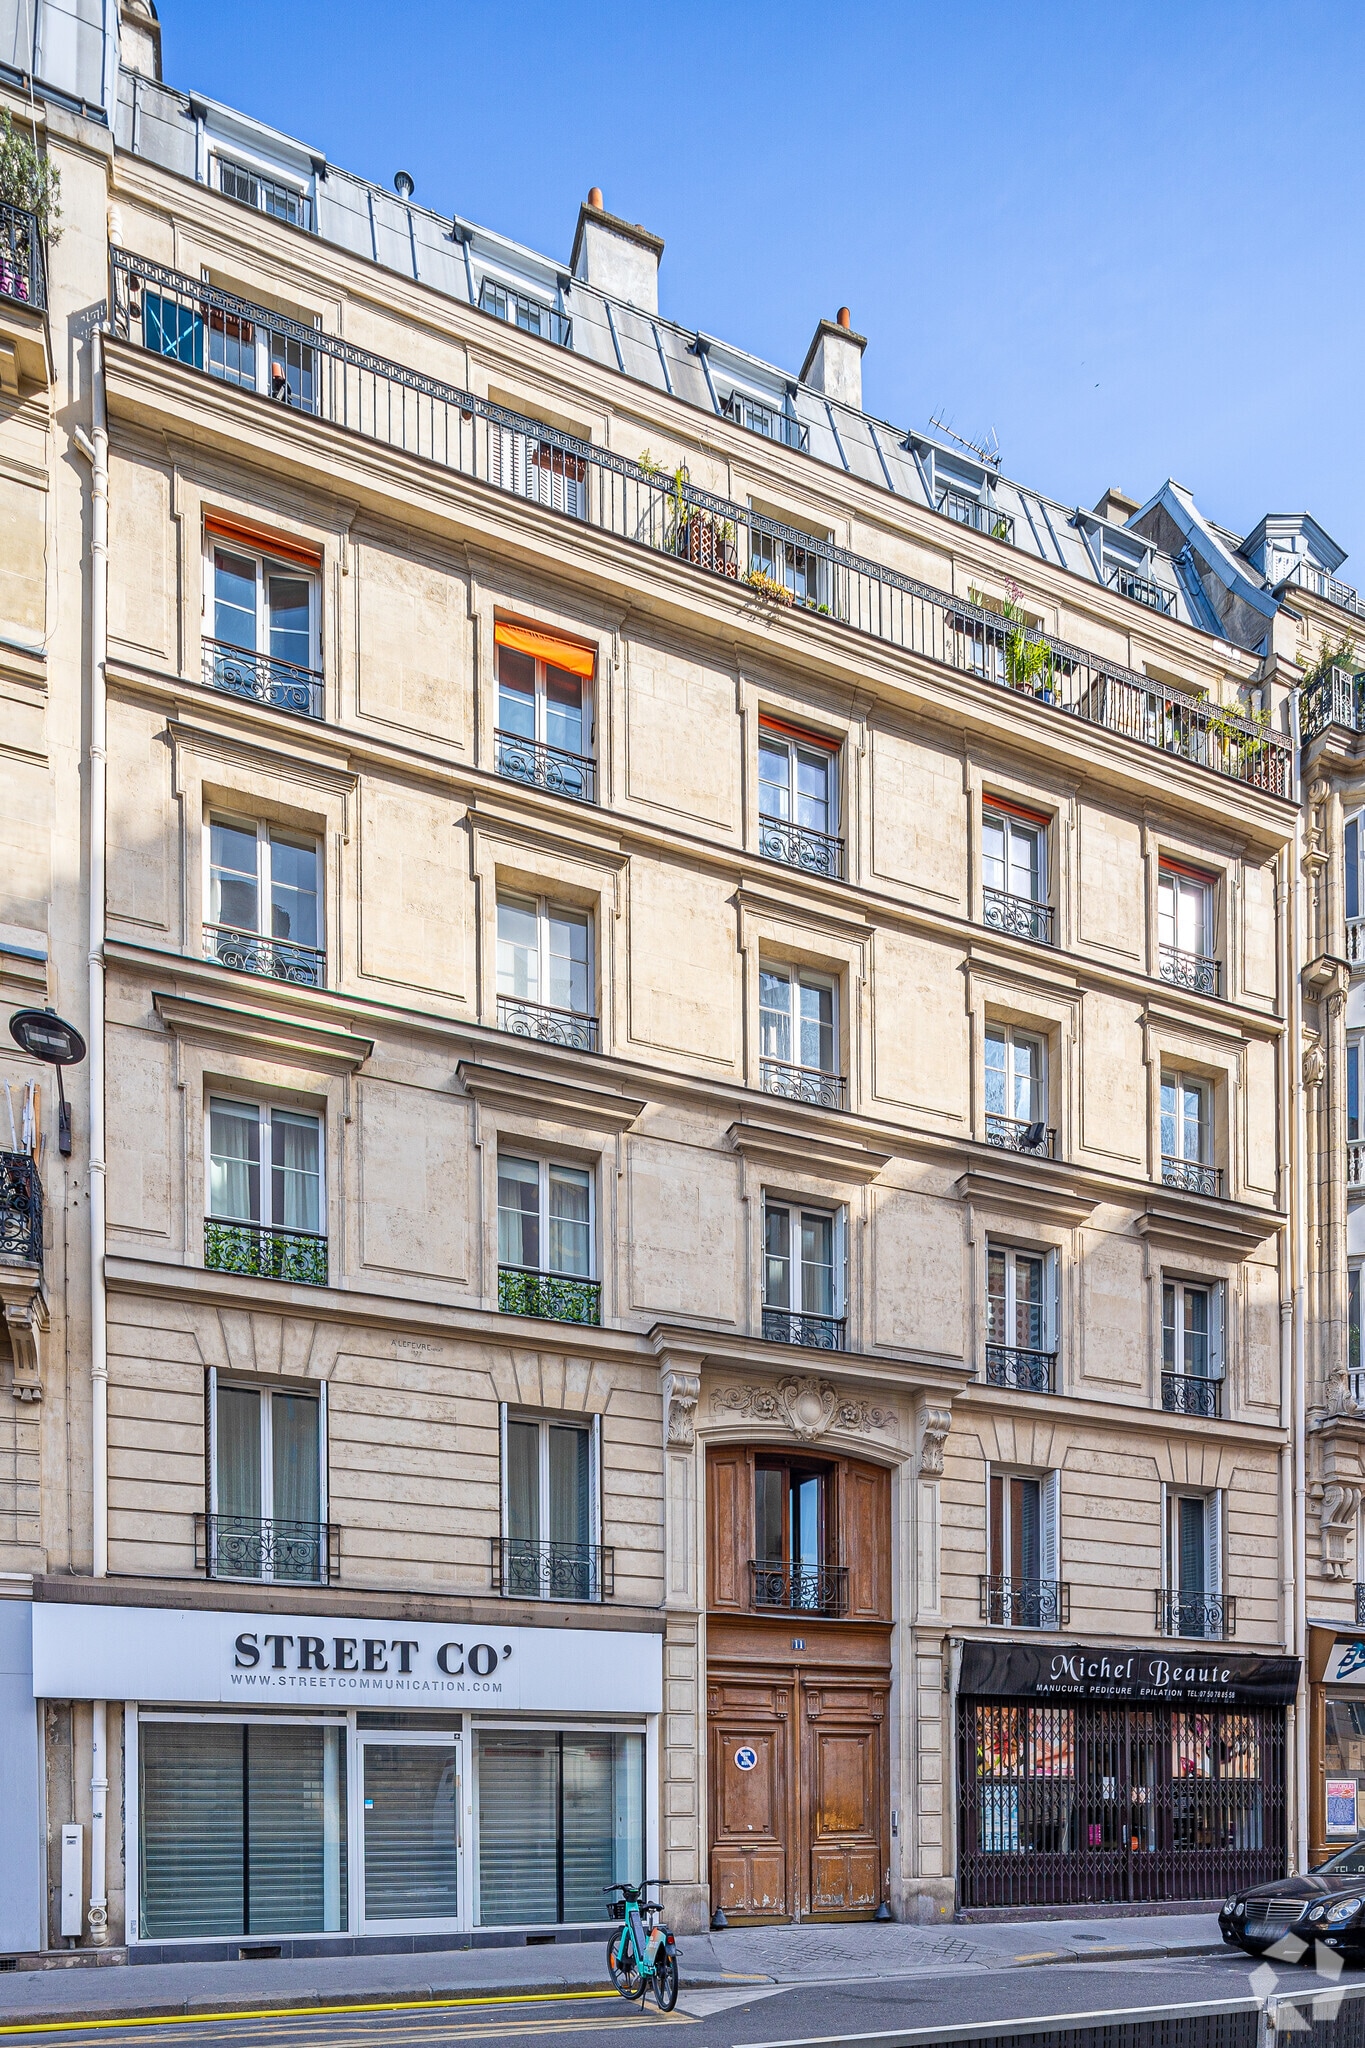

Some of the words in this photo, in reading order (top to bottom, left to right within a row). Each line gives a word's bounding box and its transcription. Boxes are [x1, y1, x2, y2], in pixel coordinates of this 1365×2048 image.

[234, 1632, 420, 1673] STREET
[230, 1674, 503, 1693] WWW.STREETCOMMUNICATION.COM
[1050, 1654, 1135, 1682] Michel
[1148, 1660, 1231, 1687] Beaute
[1036, 1683, 1085, 1693] MANUCURE
[1089, 1685, 1132, 1695] PEDICURE
[1140, 1688, 1183, 1697] EPILATION
